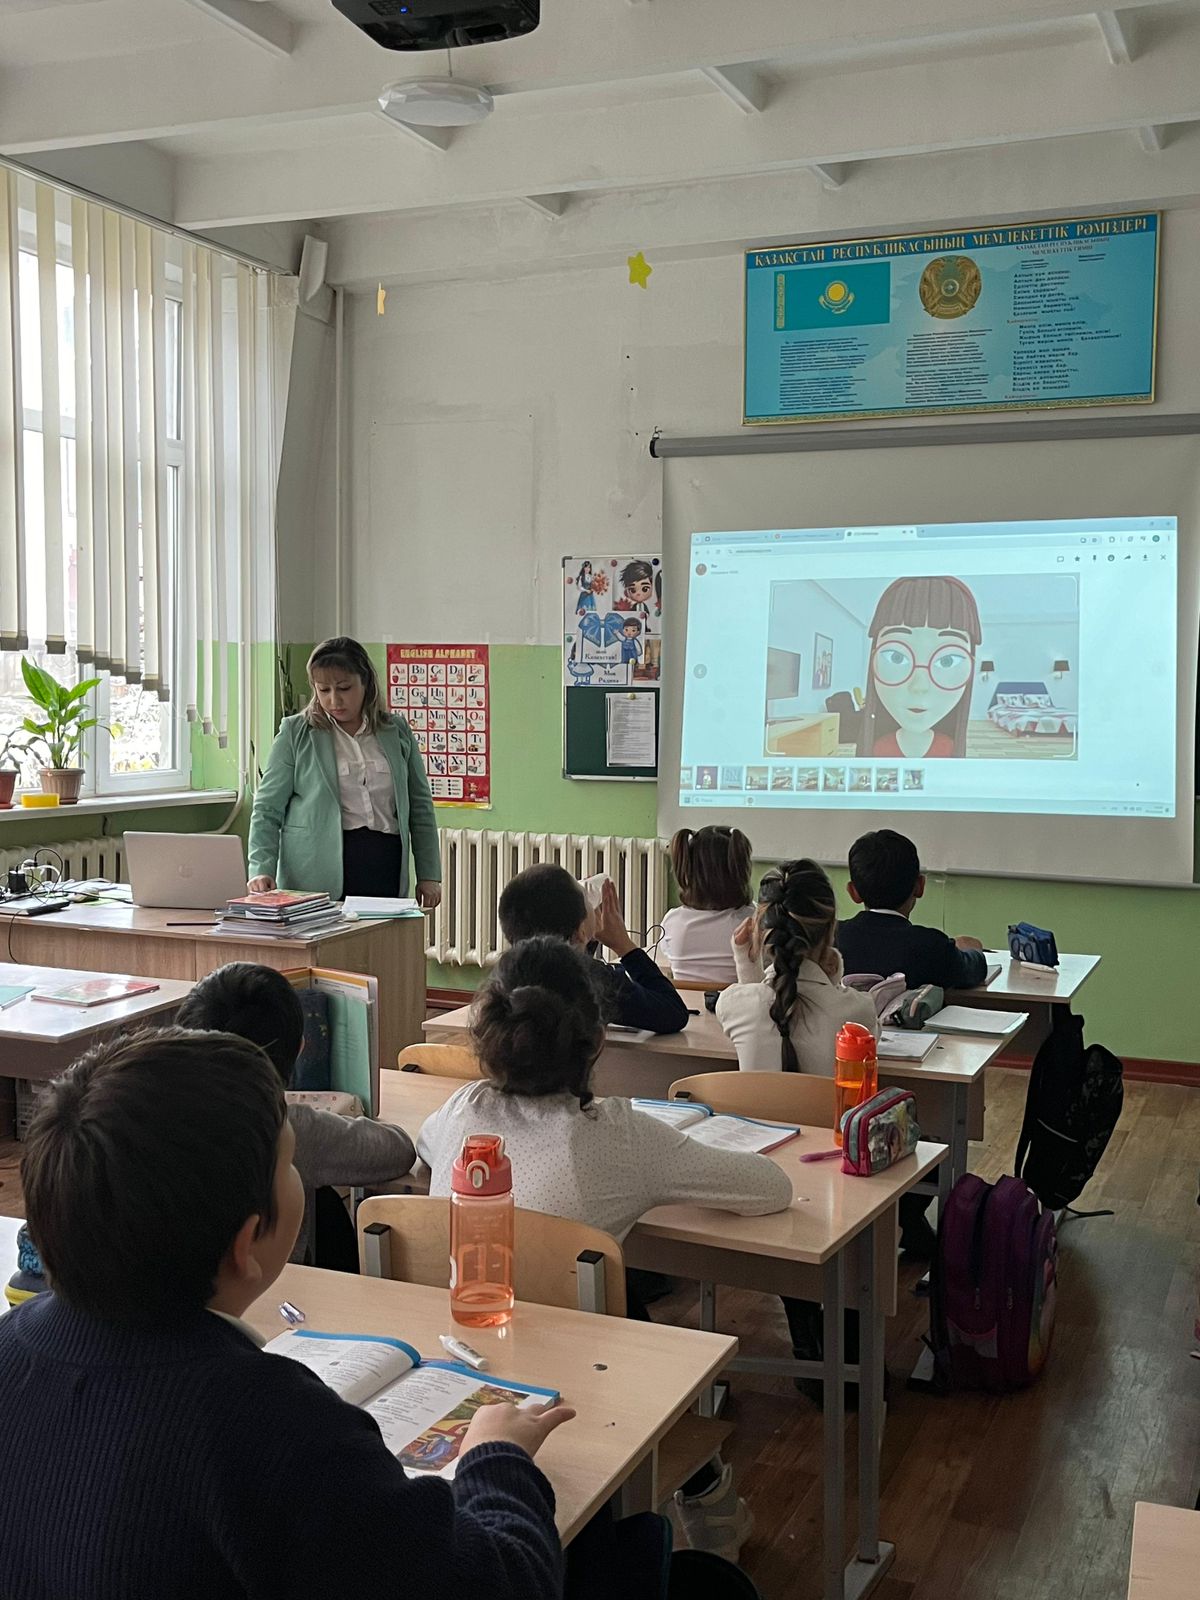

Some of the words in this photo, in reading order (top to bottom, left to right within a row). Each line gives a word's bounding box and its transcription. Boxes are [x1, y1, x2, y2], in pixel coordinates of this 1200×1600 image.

[755, 250, 825, 267] ҚАЗАҚСТАН
[832, 236, 966, 259] РЕСПУБЛИКАСЫНЫҢ
[973, 225, 1069, 246] МЕМЛЕКЕТТІК
[1077, 218, 1147, 235] РӘМІЗДЕРІ
[400, 649, 433, 658] ENGLISH
[435, 649, 476, 658] ALPHABET
